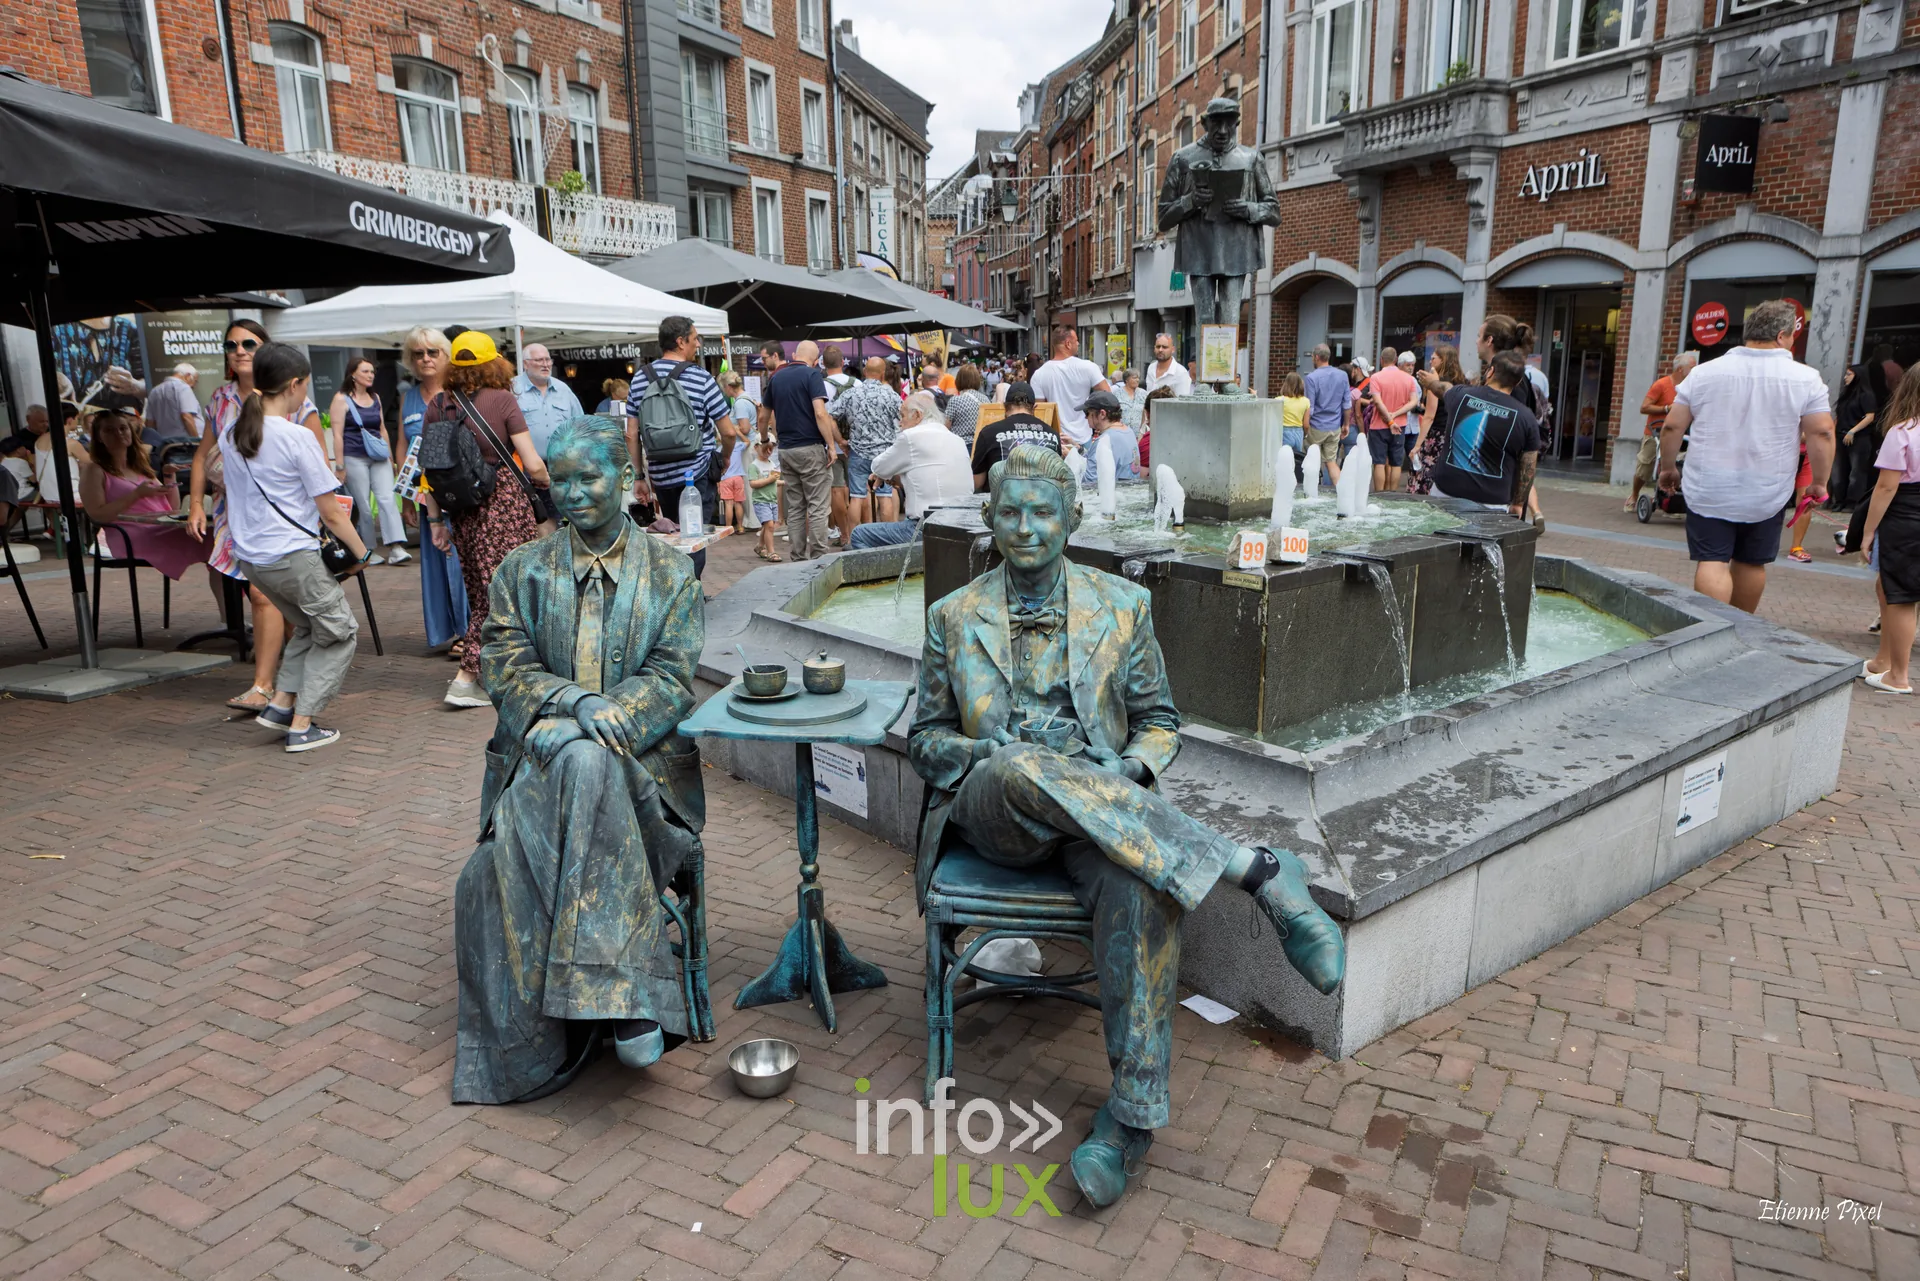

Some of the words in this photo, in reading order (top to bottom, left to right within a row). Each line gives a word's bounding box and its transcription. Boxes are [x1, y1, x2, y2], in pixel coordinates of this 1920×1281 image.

[349, 200, 474, 256] GRIMBERGEN
[162, 330, 223, 342] ARTISANAT
[559, 348, 597, 361] Glaces
[599, 346, 613, 359] de
[719, 346, 753, 355] GACIER
[995, 430, 1059, 446] SHIBUYA
[1243, 542, 1264, 562] 99
[1283, 537, 1308, 554] 100
